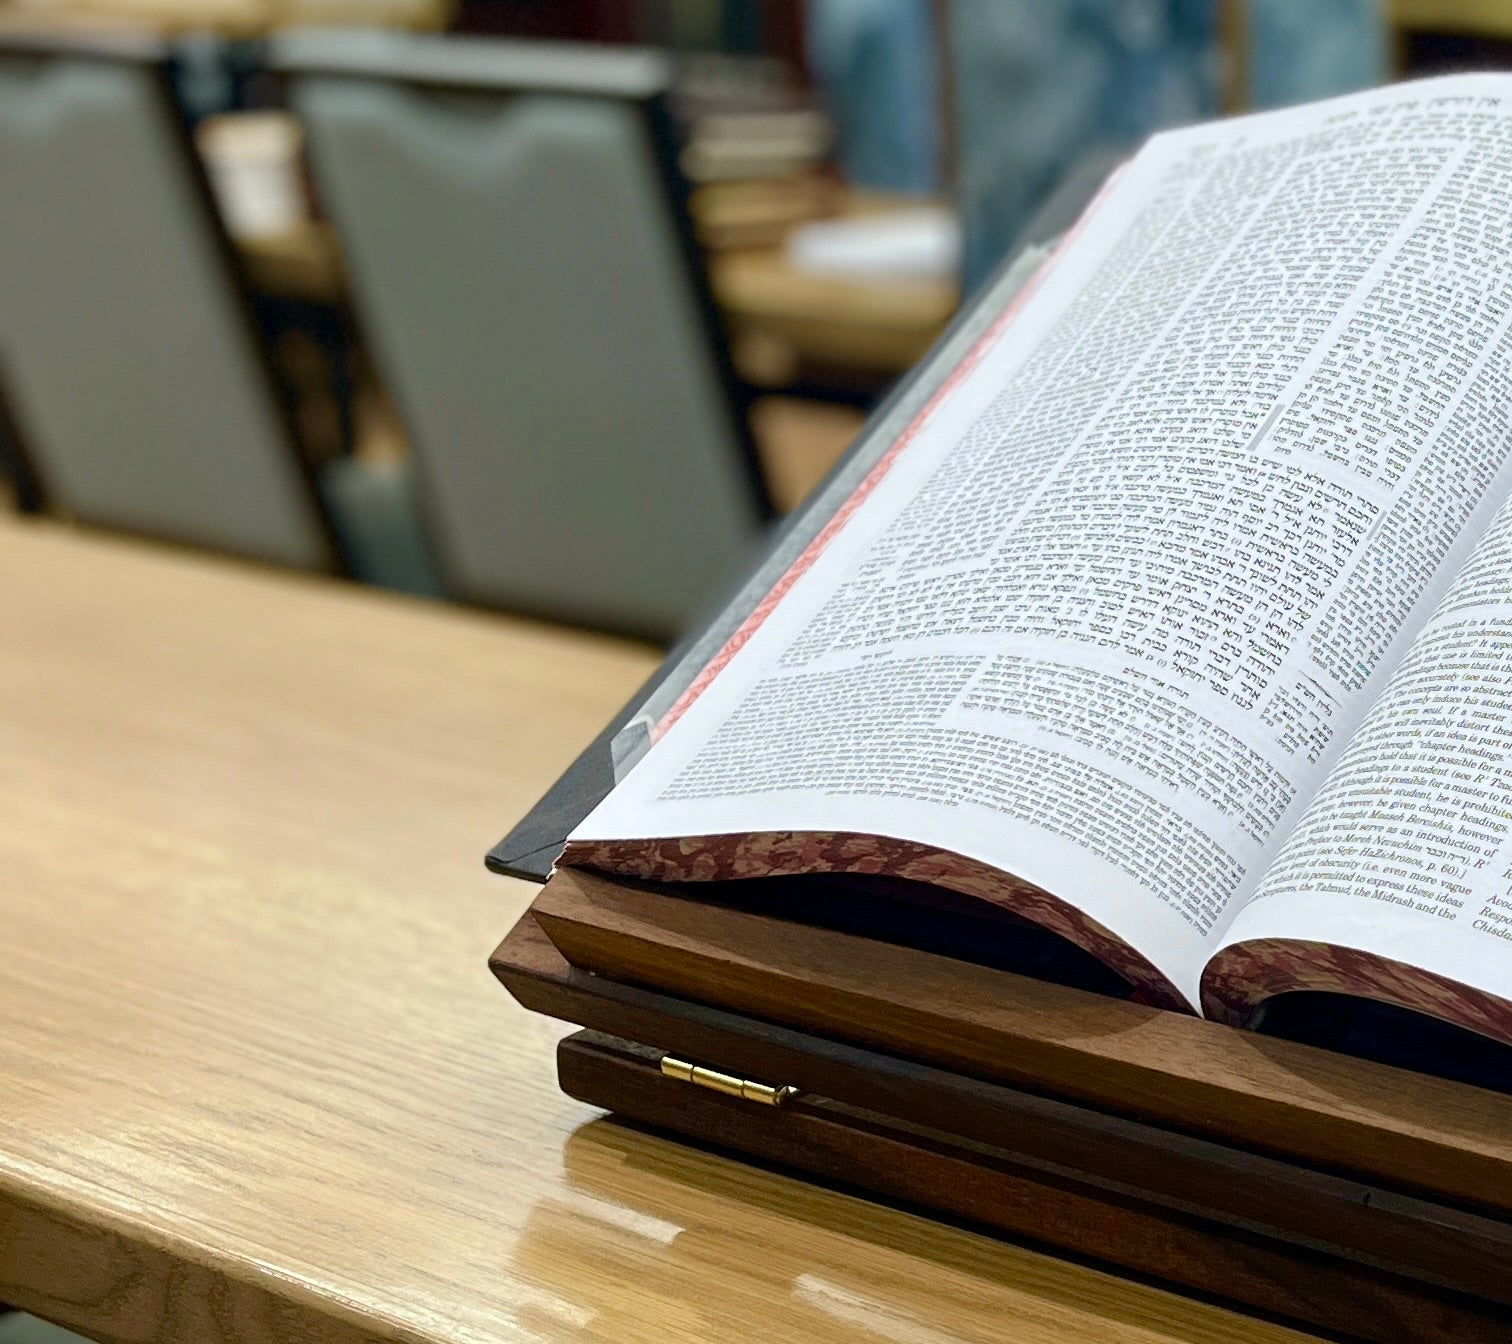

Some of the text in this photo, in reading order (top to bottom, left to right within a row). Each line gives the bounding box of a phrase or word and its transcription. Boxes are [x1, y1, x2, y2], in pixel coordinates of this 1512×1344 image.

[1299, 882, 1314, 892] the
[1353, 886, 1371, 898] the
[1371, 890, 1415, 908] Midrash
[1415, 901, 1438, 915] and
[1437, 908, 1457, 921] the
